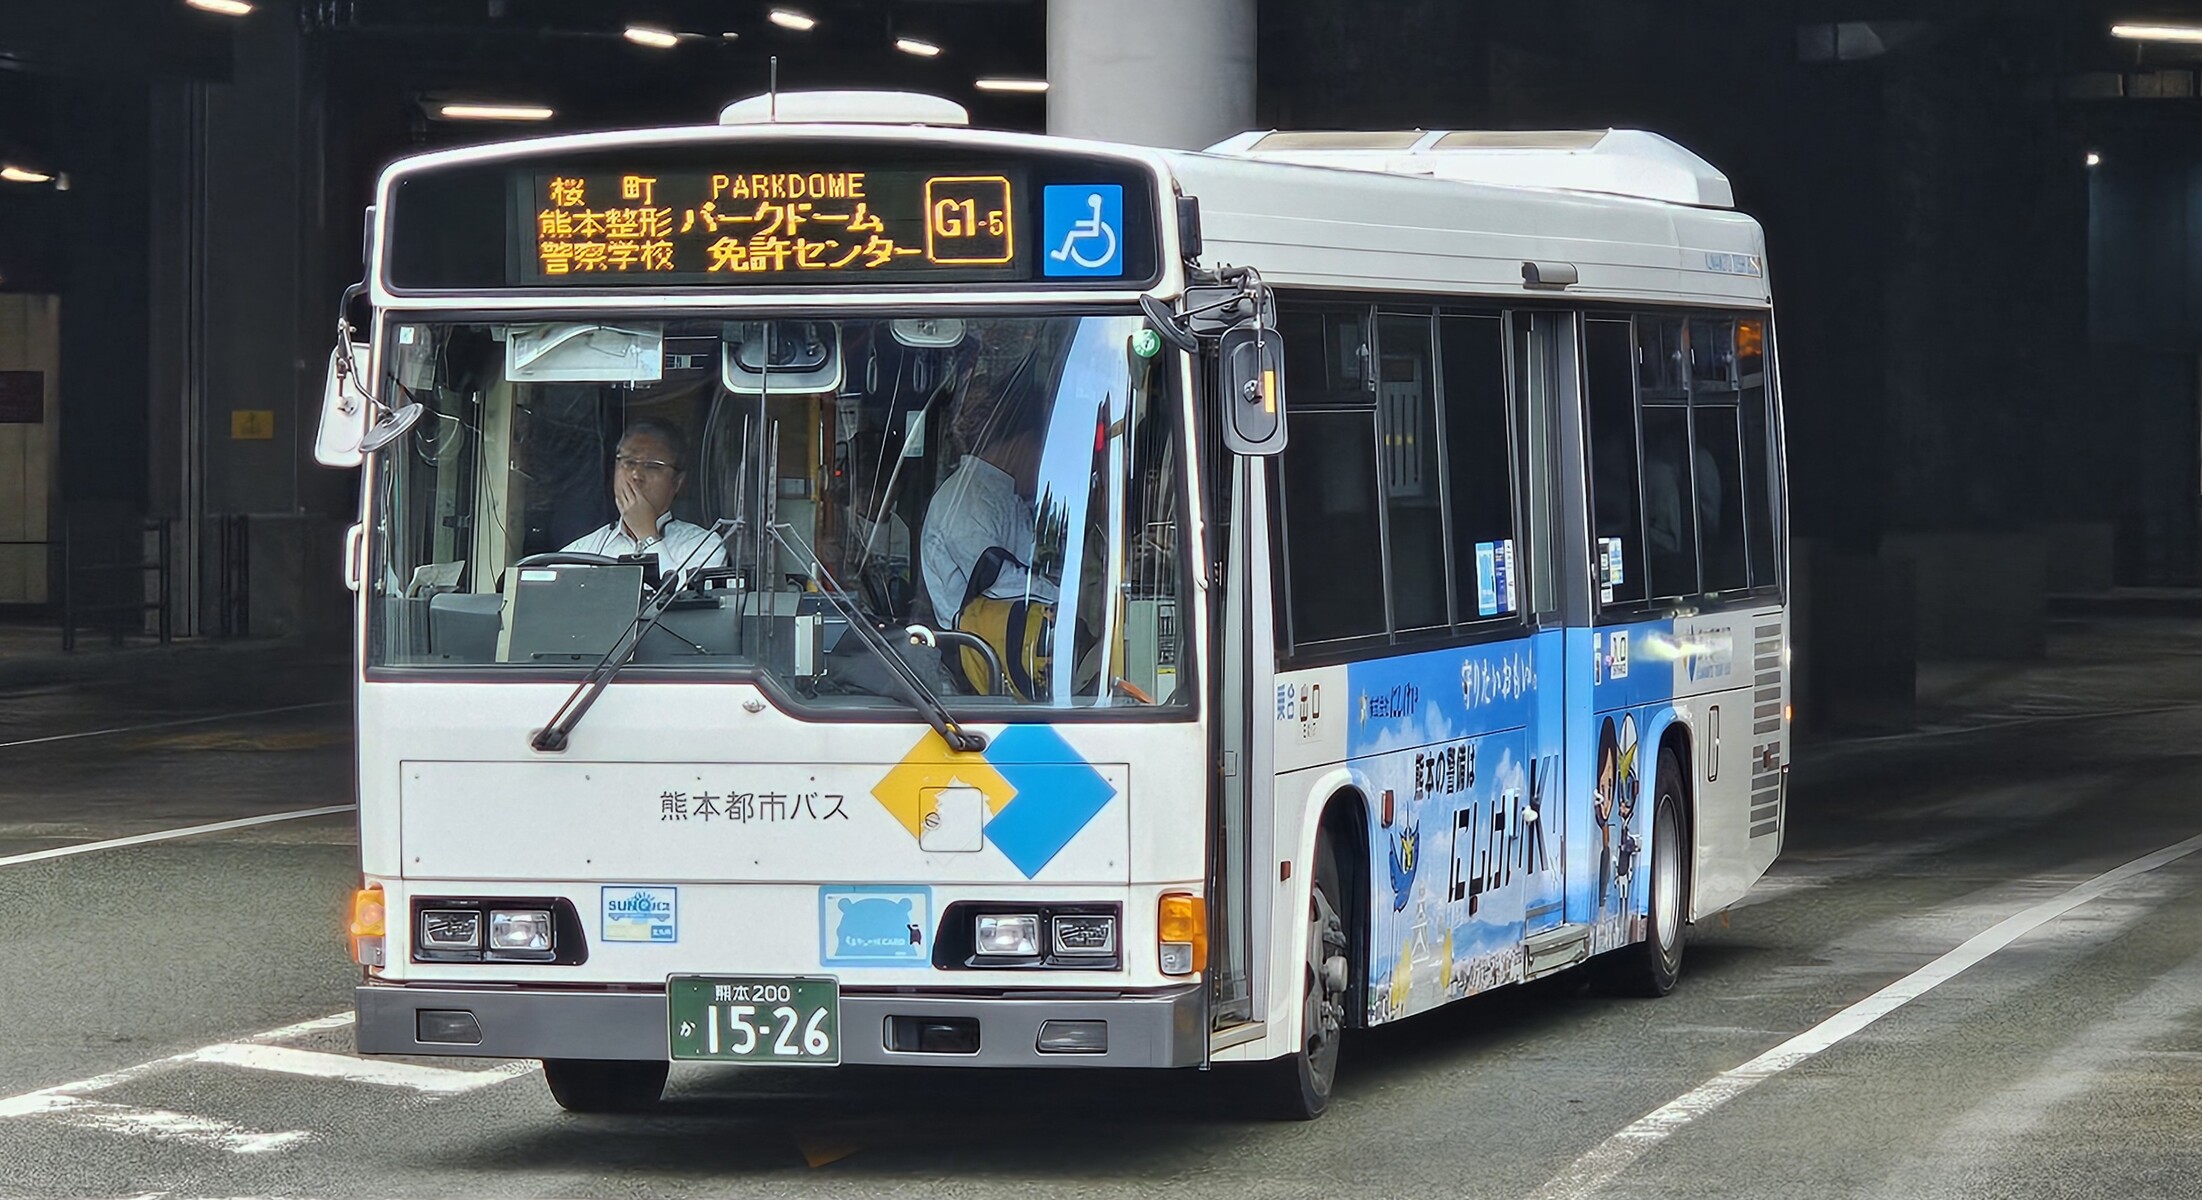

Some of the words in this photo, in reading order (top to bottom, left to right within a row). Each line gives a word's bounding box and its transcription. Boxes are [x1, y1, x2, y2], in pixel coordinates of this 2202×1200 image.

[711, 172, 866, 199] PARKDOME
[538, 207, 673, 238] 熊本整形
[680, 202, 885, 233] パークドーム
[934, 199, 1004, 237] G1-5
[539, 239, 675, 275] 警察学校
[706, 235, 922, 272] 免許センター
[660, 790, 849, 824] 熊本都市バス
[708, 1005, 830, 1056] 15-26
